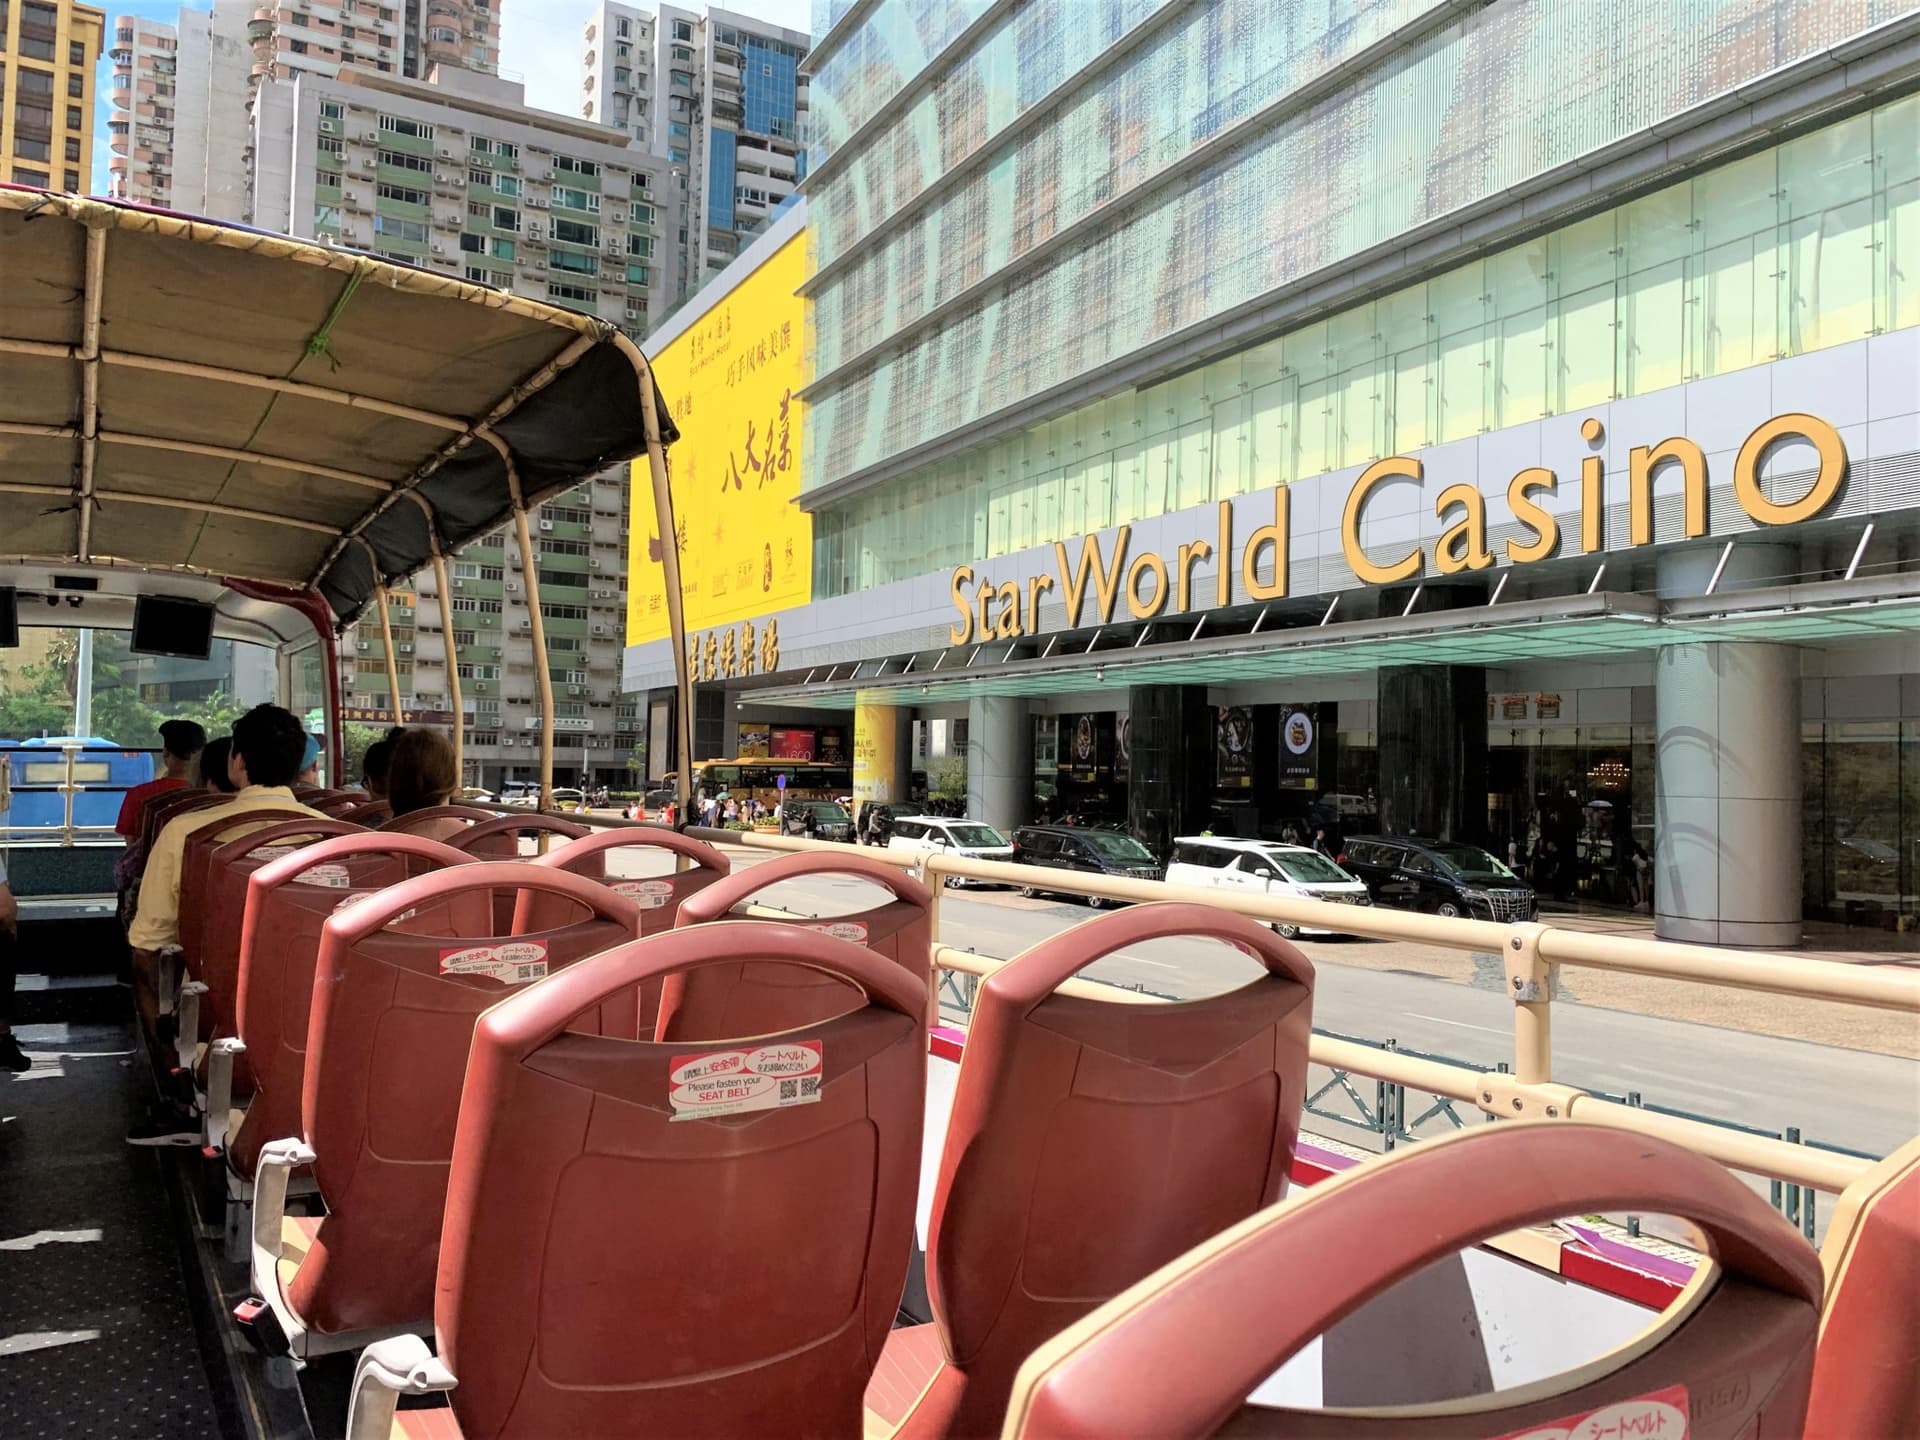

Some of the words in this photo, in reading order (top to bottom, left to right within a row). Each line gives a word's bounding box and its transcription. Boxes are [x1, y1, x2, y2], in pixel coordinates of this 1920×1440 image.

[949, 484, 1290, 648] StarWorld
[1342, 411, 1849, 586] Casino
[760, 1050, 808, 1062] シートベルト
[688, 1080, 715, 1092] Please
[716, 1078, 741, 1090] fasten
[743, 1075, 761, 1088] your
[698, 1090, 724, 1102] SEAT
[727, 1086, 751, 1098] BELT
[1590, 1410, 1667, 1440] シートベルト
